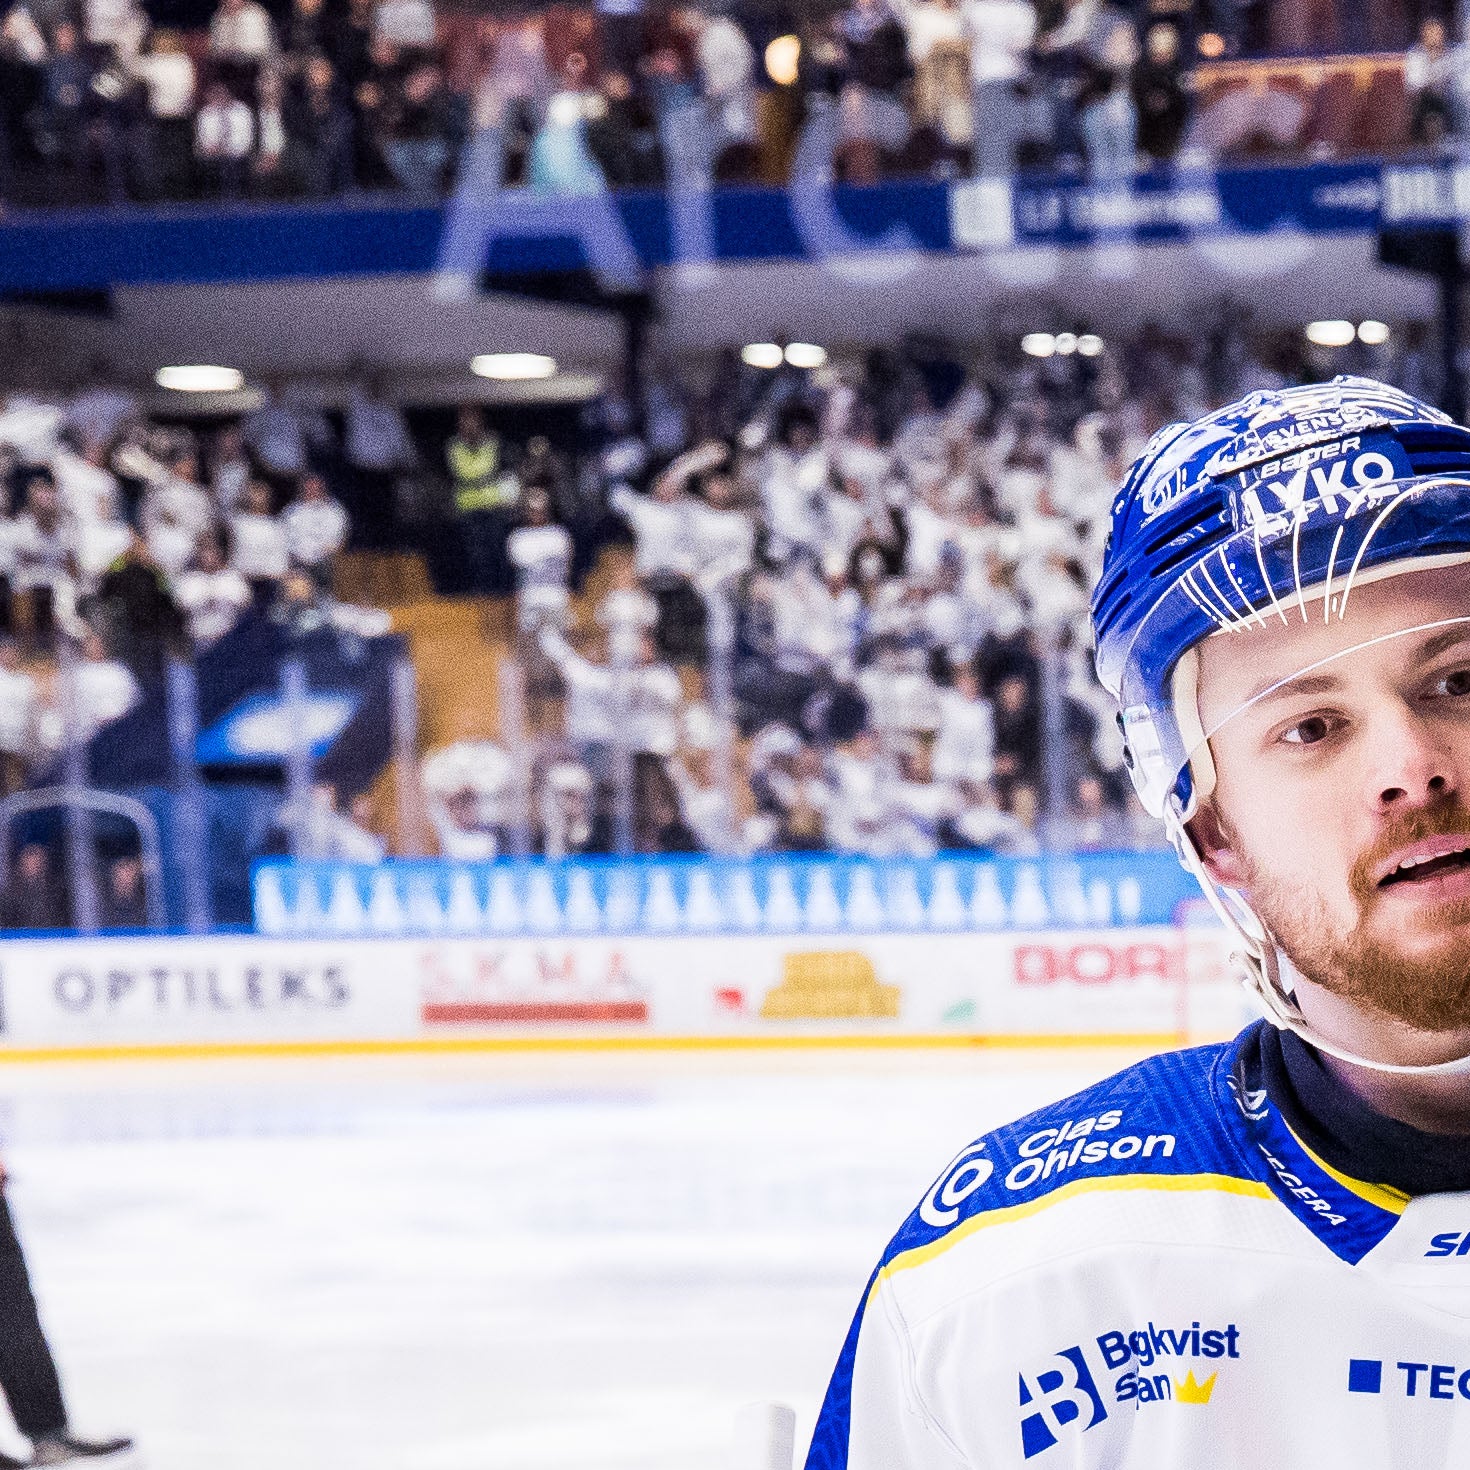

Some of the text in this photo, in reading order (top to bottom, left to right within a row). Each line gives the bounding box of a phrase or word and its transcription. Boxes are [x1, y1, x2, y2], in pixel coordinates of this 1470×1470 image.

[1245, 450, 1400, 538] LYKO
[1005, 1133, 1176, 1191] Ohlson
[1018, 1109, 1124, 1159] Clas
